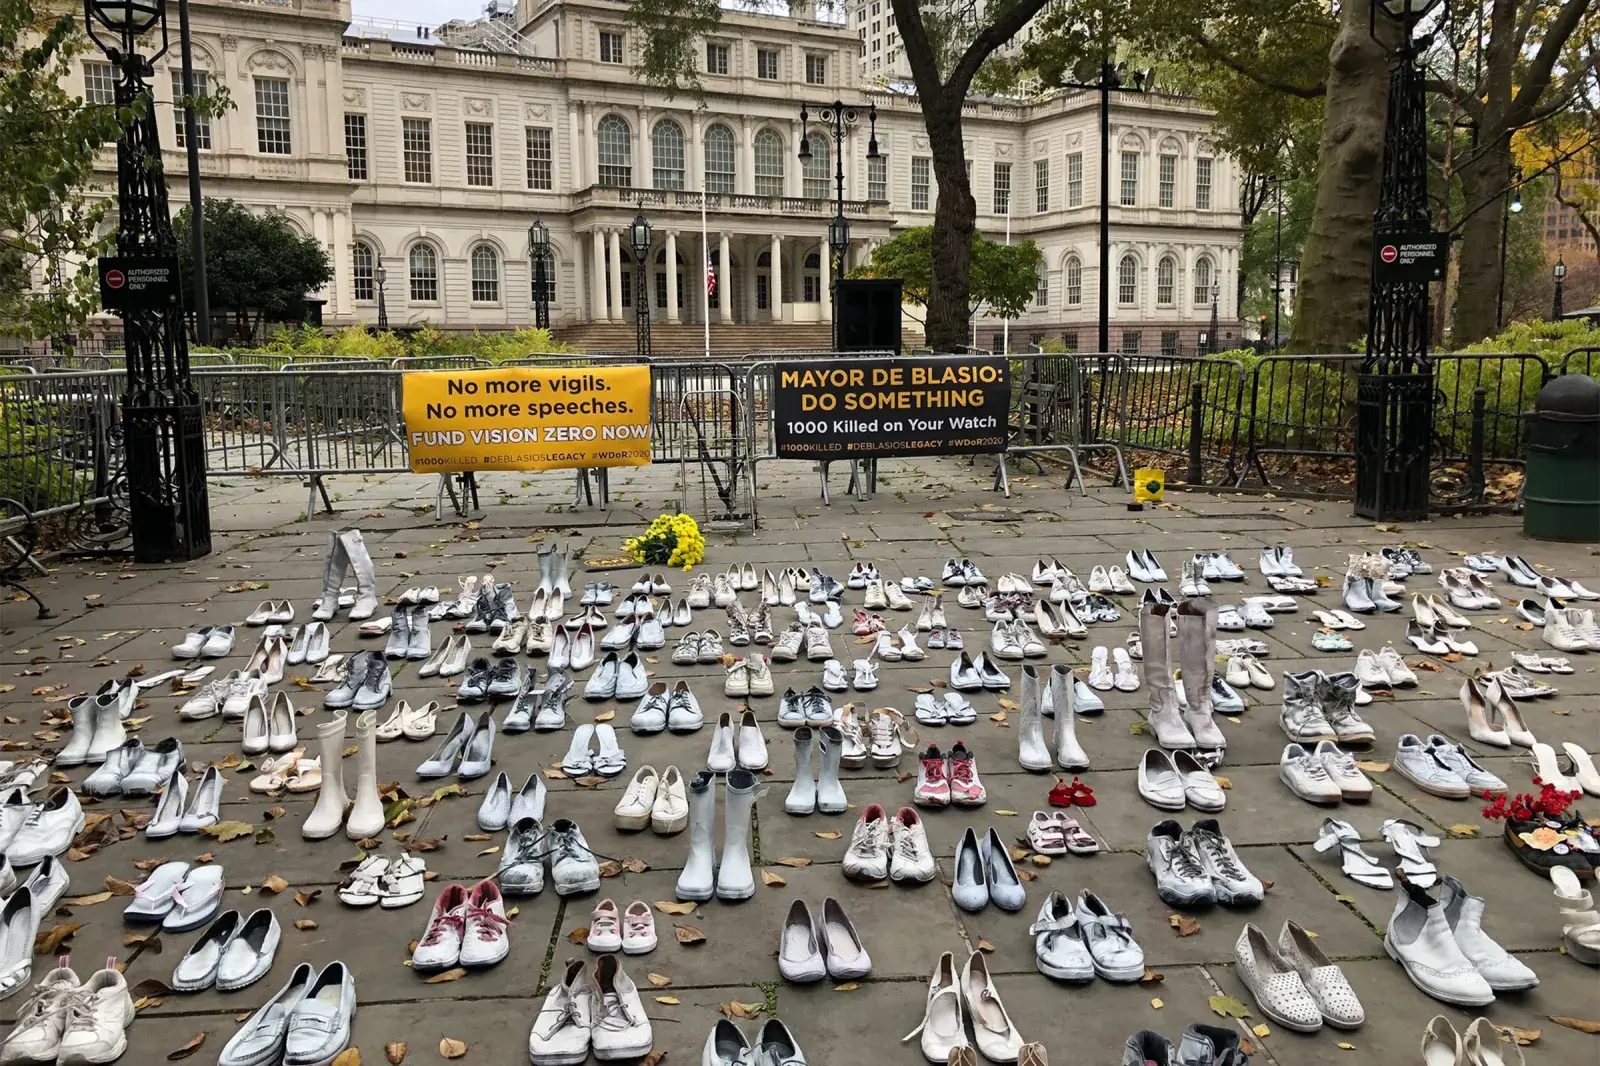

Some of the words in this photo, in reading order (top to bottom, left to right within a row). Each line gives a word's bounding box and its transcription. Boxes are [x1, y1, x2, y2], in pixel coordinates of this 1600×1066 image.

[448, 379, 478, 395] No
[486, 379, 541, 393] more
[548, 375, 611, 394] vigils.
[782, 369, 864, 388] MAYOR
[873, 368, 903, 386] DE
[912, 366, 1003, 385] BLASIO:
[427, 403, 457, 419] No
[465, 403, 520, 417] more
[528, 398, 633, 419] speeches.
[802, 393, 836, 411] DO
[844, 389, 984, 410] SOMETHING
[787, 421, 827, 434] 1000
[834, 419, 878, 433] Killed
[884, 421, 902, 432] on
[908, 418, 944, 431] Your
[949, 415, 996, 429] Watch
[411, 431, 465, 447] FUND
[471, 427, 538, 444] VISION
[544, 426, 596, 442] ZERO
[602, 424, 649, 440] NOW
[781, 443, 842, 451] #1000KILLED
[847, 440, 943, 451] #DEBLASIOSLEGACY
[948, 437, 1003, 447] #WDoR2020
[415, 456, 478, 465] #1000KILLED
[484, 453, 586, 464] #DEBLASIOSLEGACY
[592, 450, 651, 460] #WDoR2020
